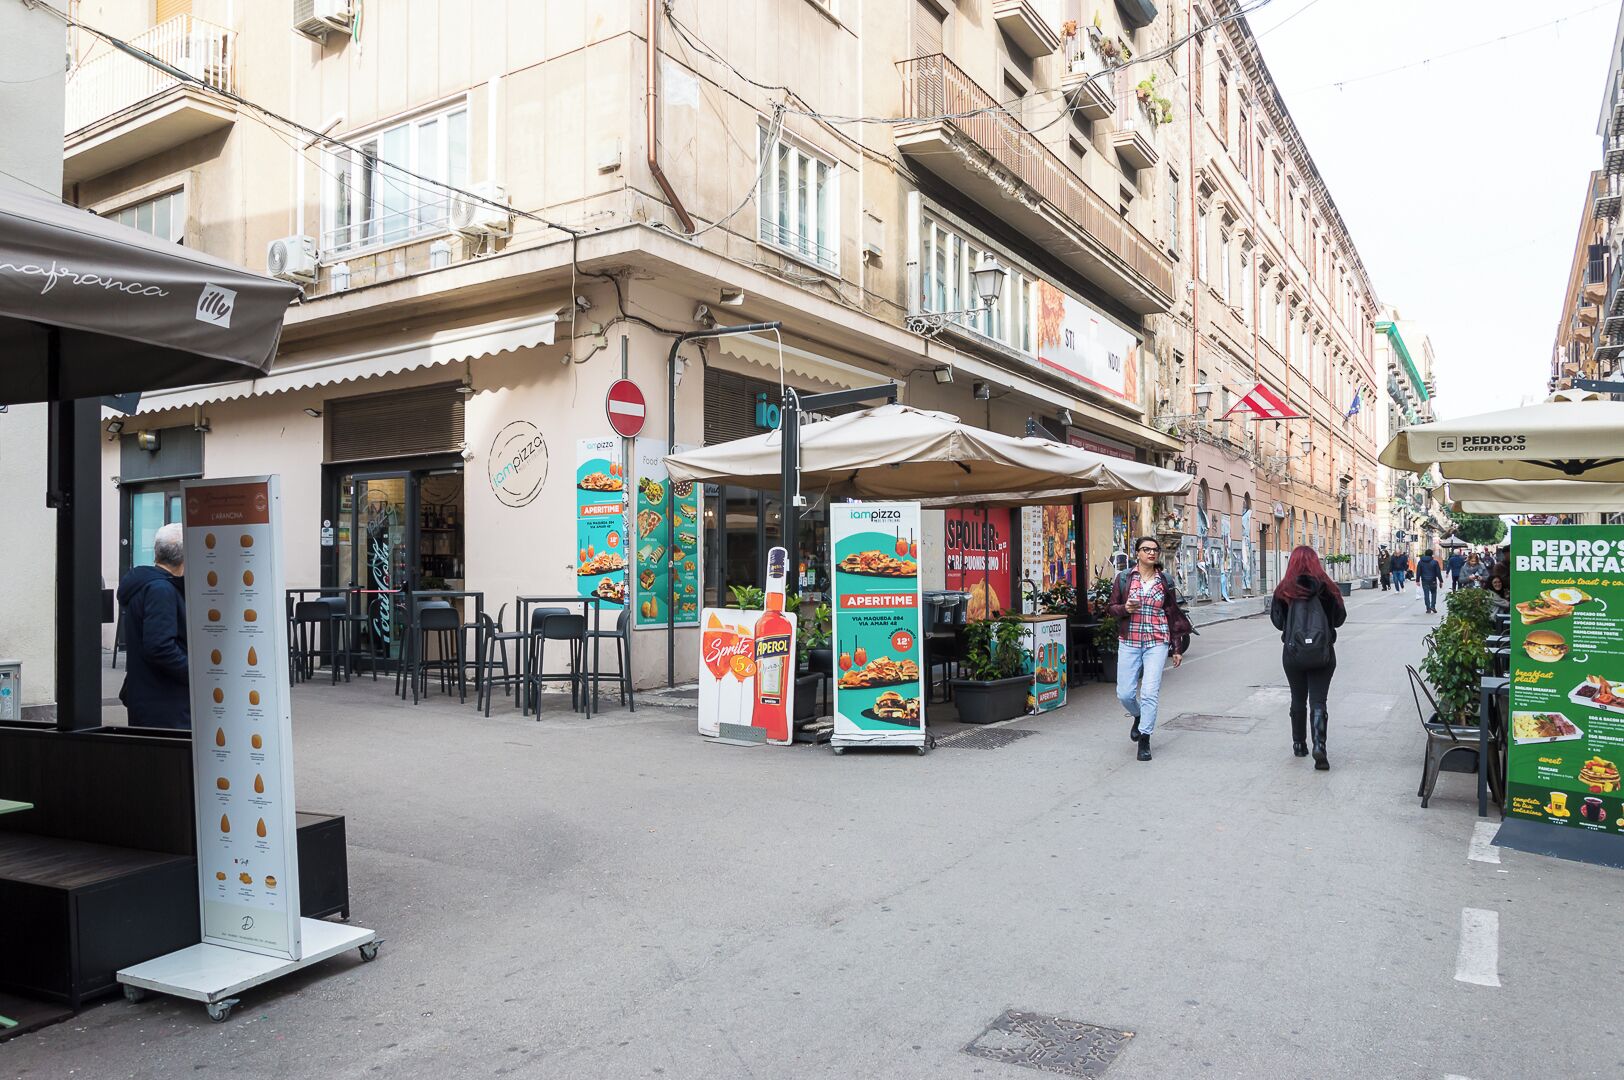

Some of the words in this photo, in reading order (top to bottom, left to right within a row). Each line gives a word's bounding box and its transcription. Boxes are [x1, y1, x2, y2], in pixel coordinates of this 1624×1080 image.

[199, 291, 231, 321] illy
[1462, 435, 1526, 445] PEDRO'S
[493, 436, 543, 488] iampizza
[584, 505, 620, 515] APERITIME
[850, 508, 901, 522] iampizza
[1541, 577, 1576, 585] avocado
[847, 596, 913, 606] APERITIME
[756, 639, 788, 656] APEROL
[1515, 668, 1554, 679] breakfast
